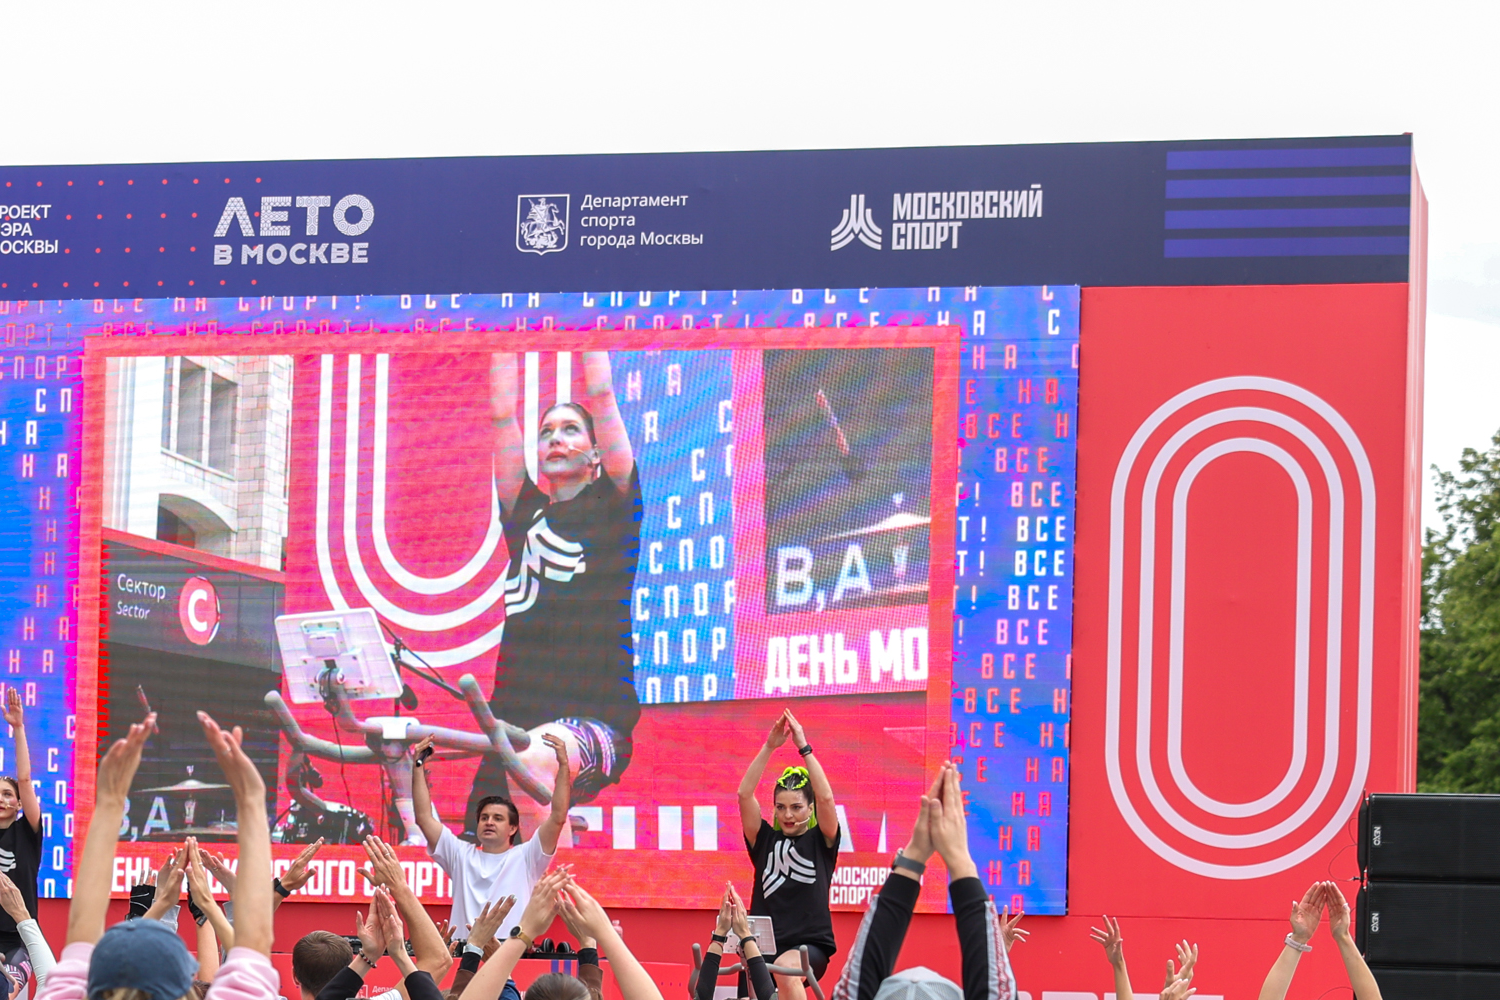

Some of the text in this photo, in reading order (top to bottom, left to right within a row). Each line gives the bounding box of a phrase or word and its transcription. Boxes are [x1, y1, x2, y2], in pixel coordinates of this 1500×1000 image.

[213, 193, 375, 237] ЛЕТО
[580, 193, 688, 211] Департамент
[893, 184, 1043, 221] МОСКОВСКИЙ
[580, 213, 636, 231] спорта
[580, 230, 704, 249] города Москвы
[891, 221, 963, 251] СПОРТ
[213, 242, 369, 266] В МОСКВЕ
[1016, 515, 1066, 543] ВСЕ
[1014, 549, 1065, 577] ВСЕ
[116, 573, 167, 602] Сектор
[1008, 584, 1059, 611] ВСЕ
[115, 600, 151, 620] Sector
[996, 618, 1049, 646] ВСЕ
[764, 632, 859, 694] ДЕНЬ
[980, 653, 1037, 680] ВСЕ
[963, 687, 1022, 714] ВСЕ
[1371, 912, 1380, 932] NEXO
